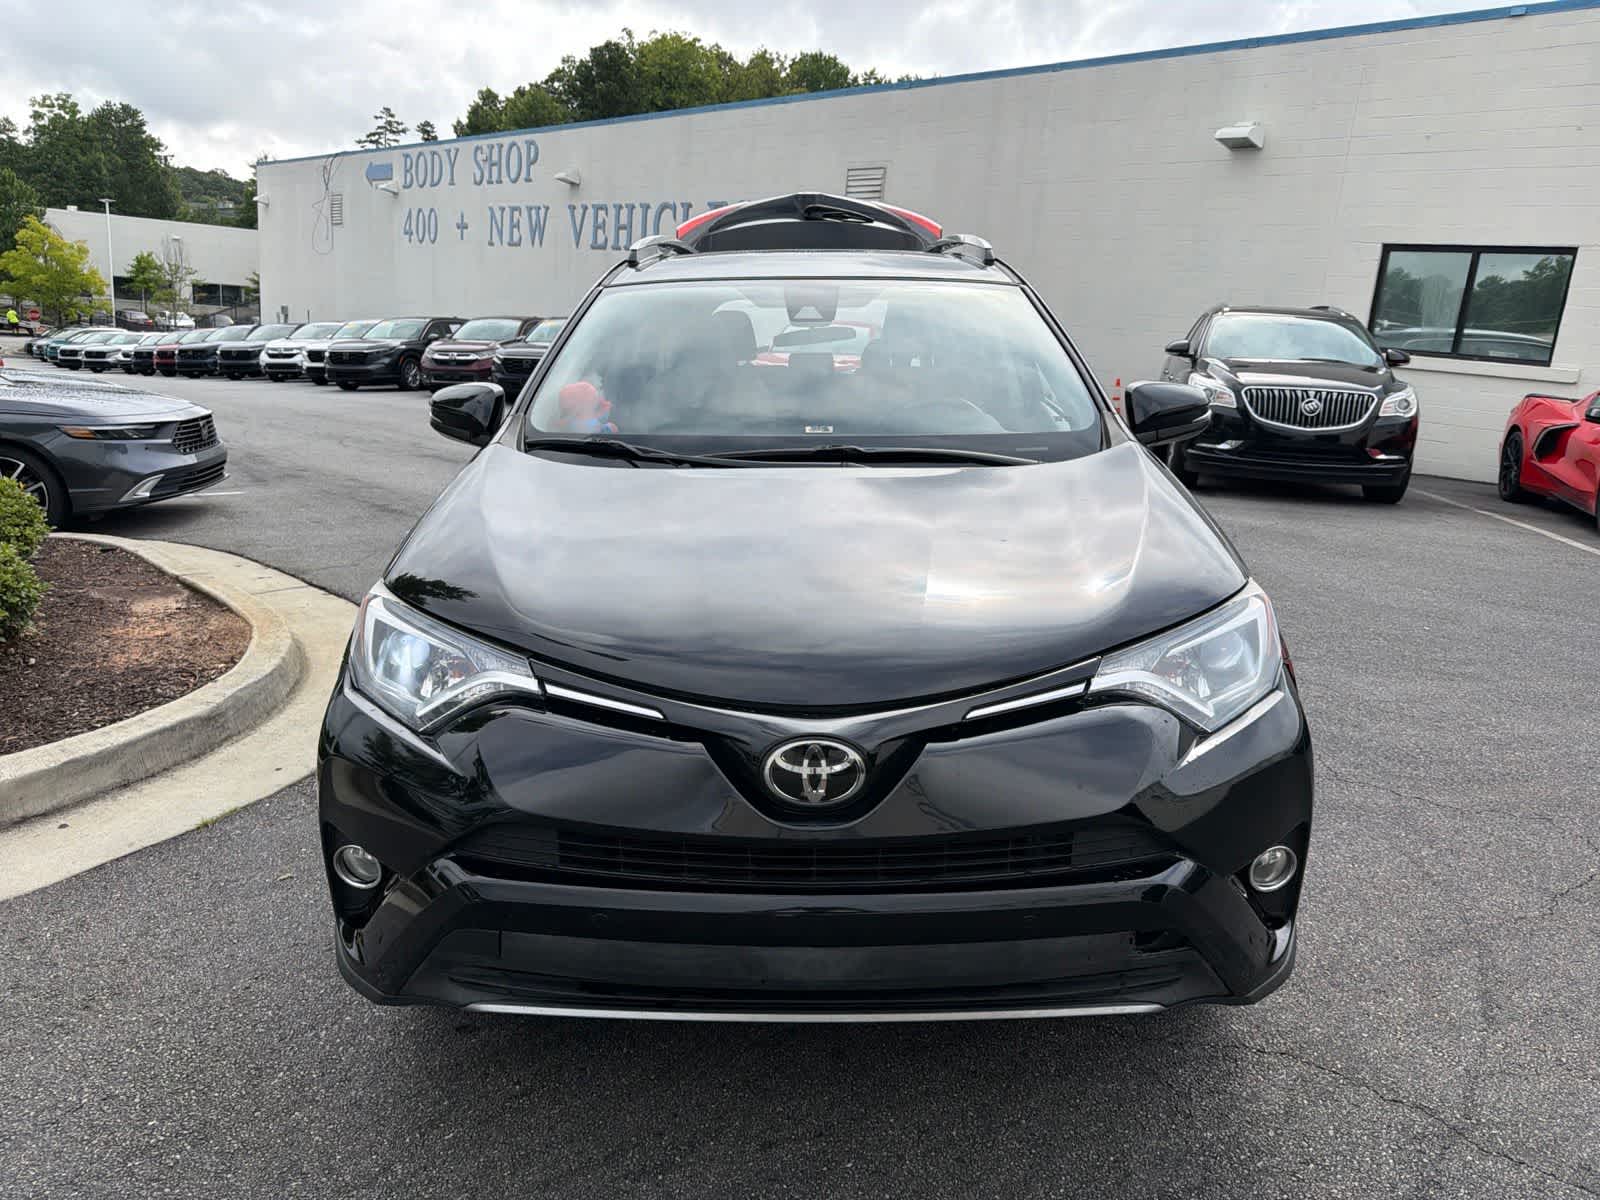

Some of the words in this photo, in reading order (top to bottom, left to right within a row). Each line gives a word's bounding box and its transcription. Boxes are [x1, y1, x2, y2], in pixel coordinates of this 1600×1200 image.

[402, 147, 460, 189] BODY
[473, 139, 540, 186] SHOP
[403, 207, 438, 244] 400
[456, 210, 469, 240] +
[487, 204, 550, 248] NEW
[568, 200, 728, 250] VEHIC
